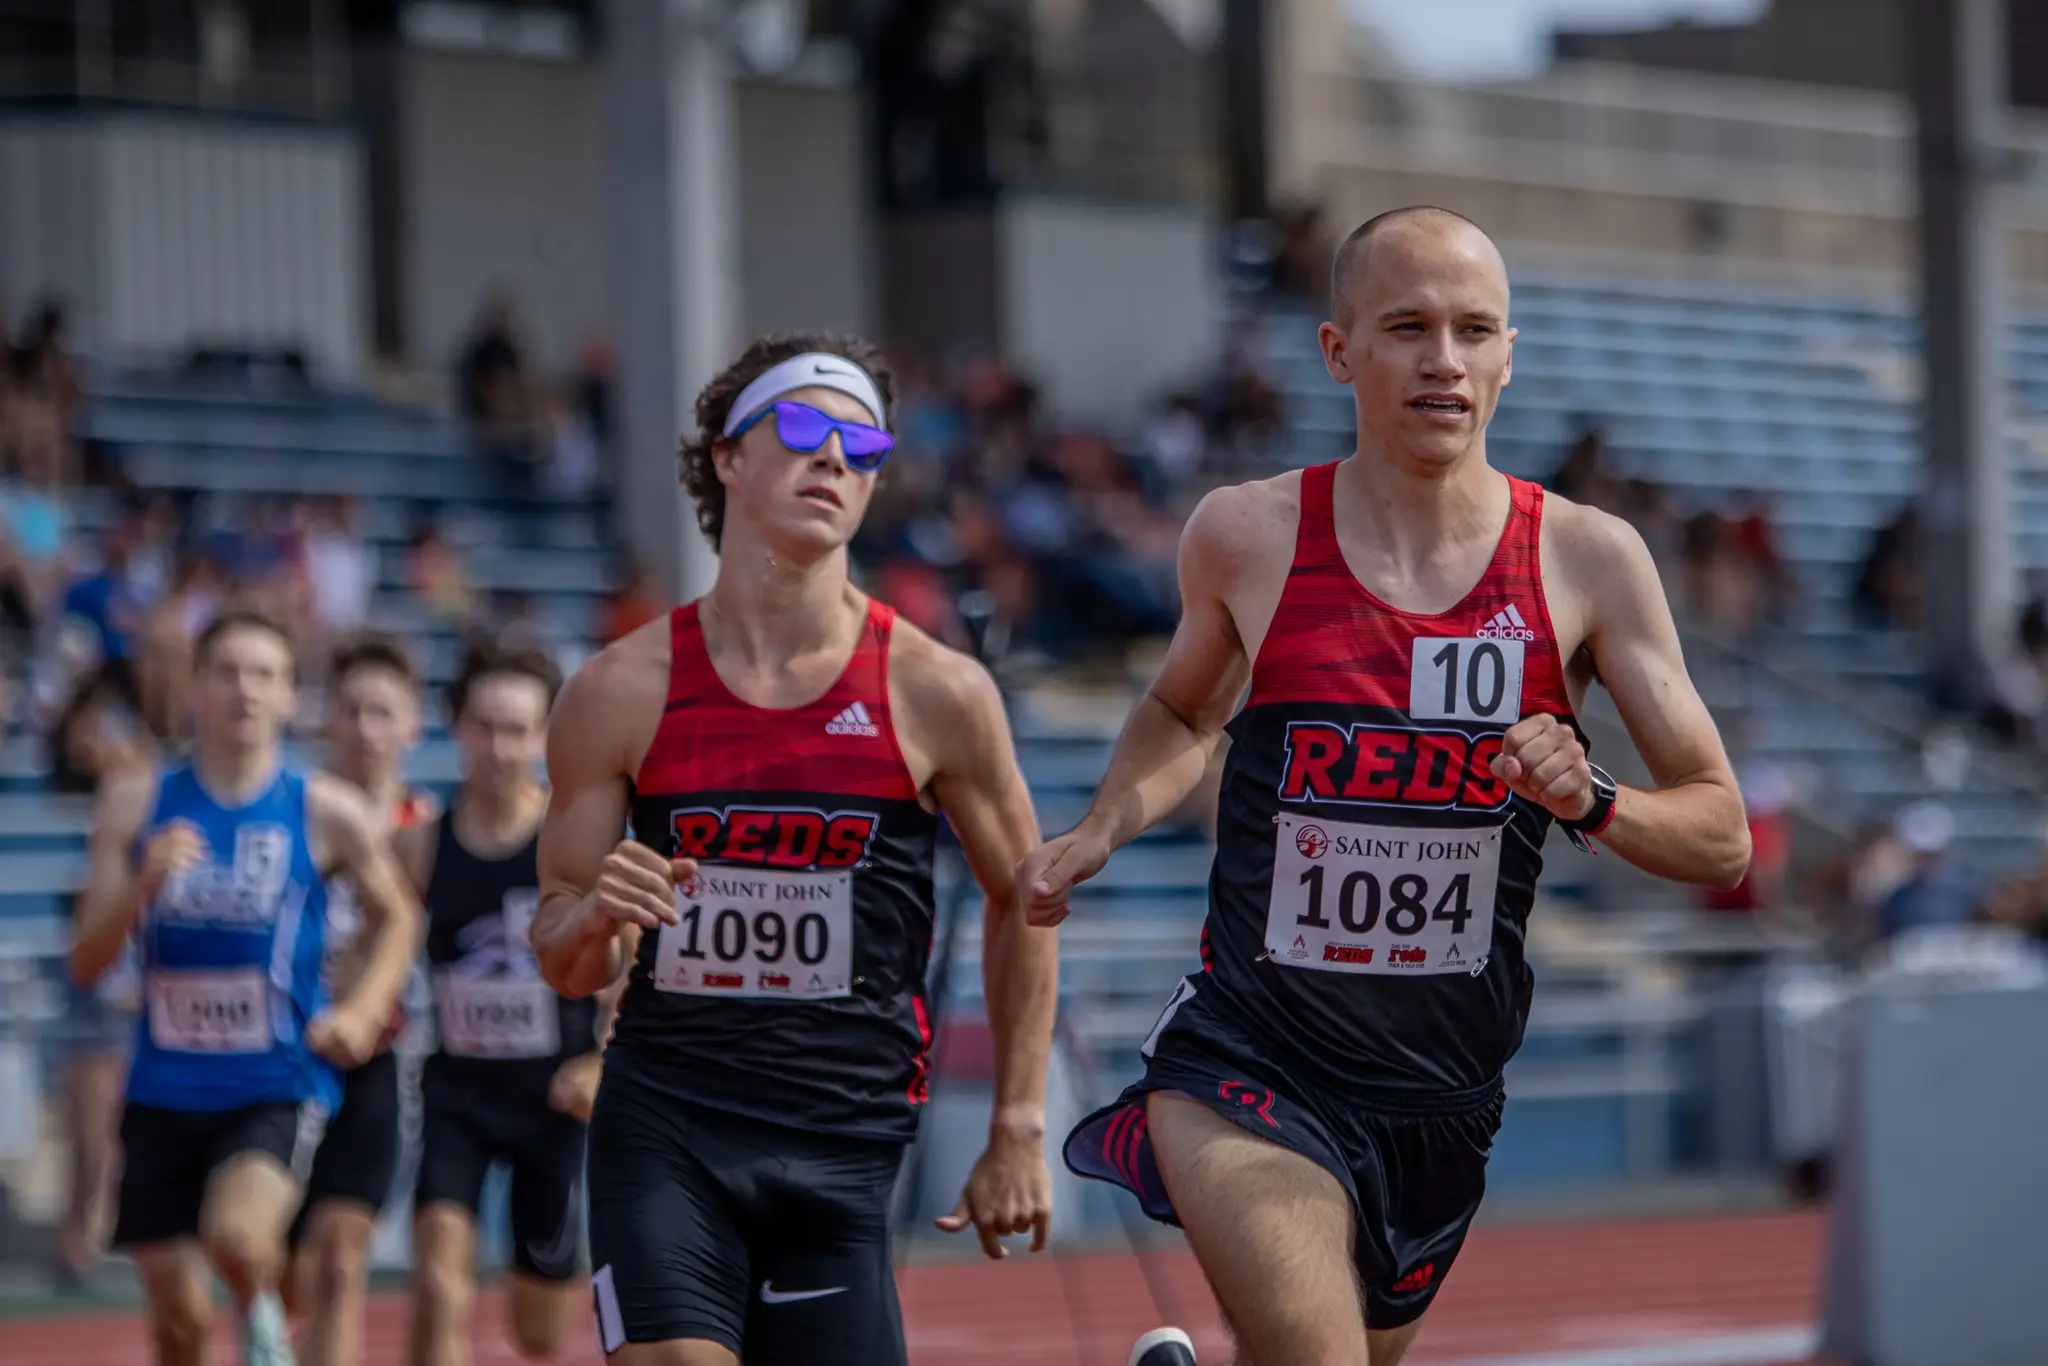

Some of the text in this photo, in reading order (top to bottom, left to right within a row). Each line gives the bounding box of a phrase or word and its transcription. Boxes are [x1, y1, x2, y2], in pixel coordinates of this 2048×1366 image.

[1476, 626, 1534, 641] adidas
[1432, 641, 1505, 717] 10
[825, 722, 879, 737] adidas
[1279, 722, 1513, 812] REDS
[670, 804, 881, 871] REDS
[1335, 836, 1481, 862] SAINT JOHN
[709, 878, 833, 901] SAINT JOHN
[1296, 865, 1472, 935] 1084
[677, 905, 830, 965] 1090
